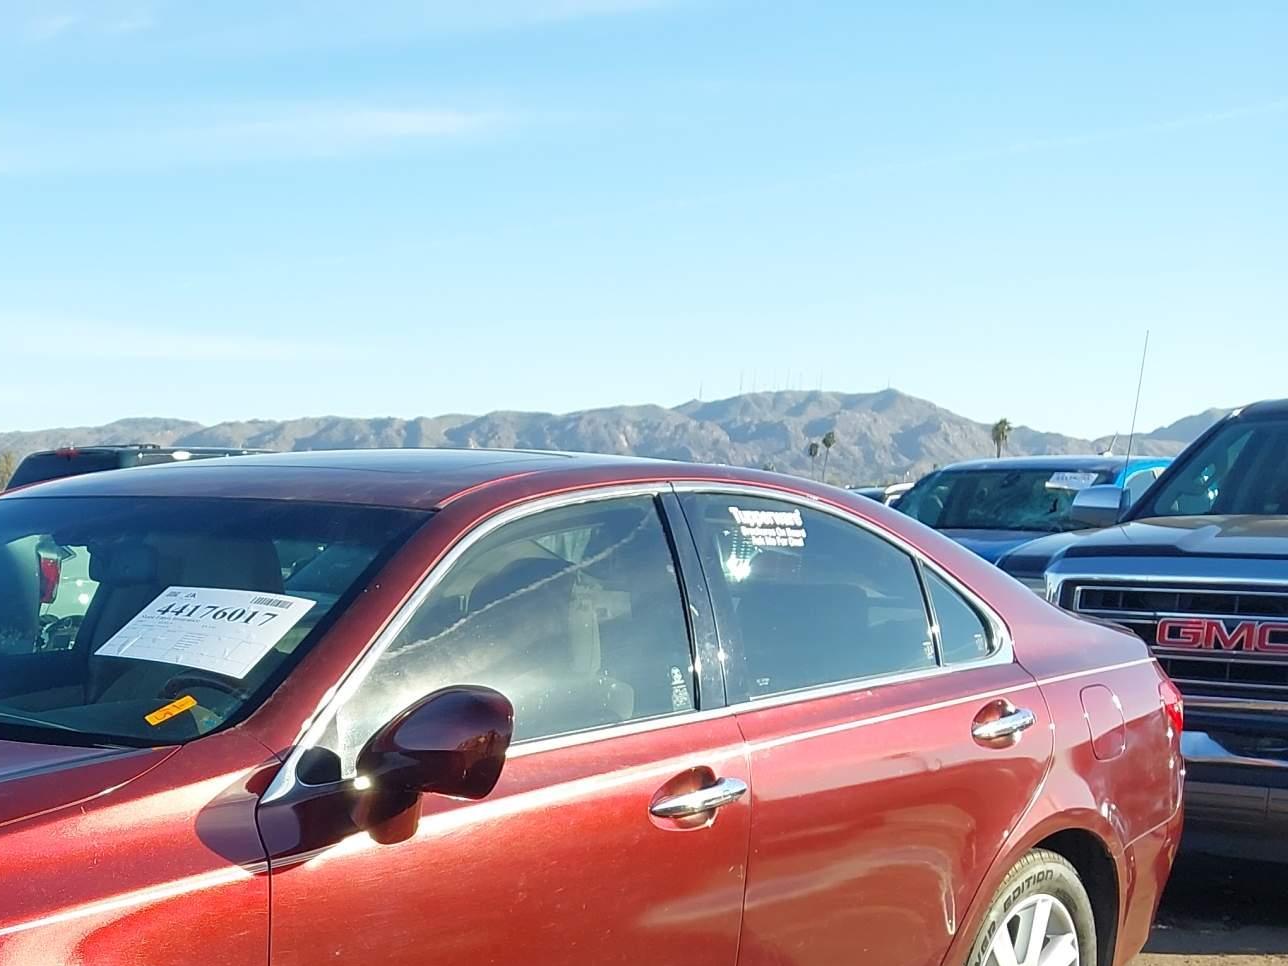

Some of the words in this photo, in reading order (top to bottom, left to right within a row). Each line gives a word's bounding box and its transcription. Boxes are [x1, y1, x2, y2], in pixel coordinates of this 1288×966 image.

[156, 603, 278, 627] 44176017
[1157, 617, 1288, 653] GMC
[1003, 869, 1054, 913] EDITION
